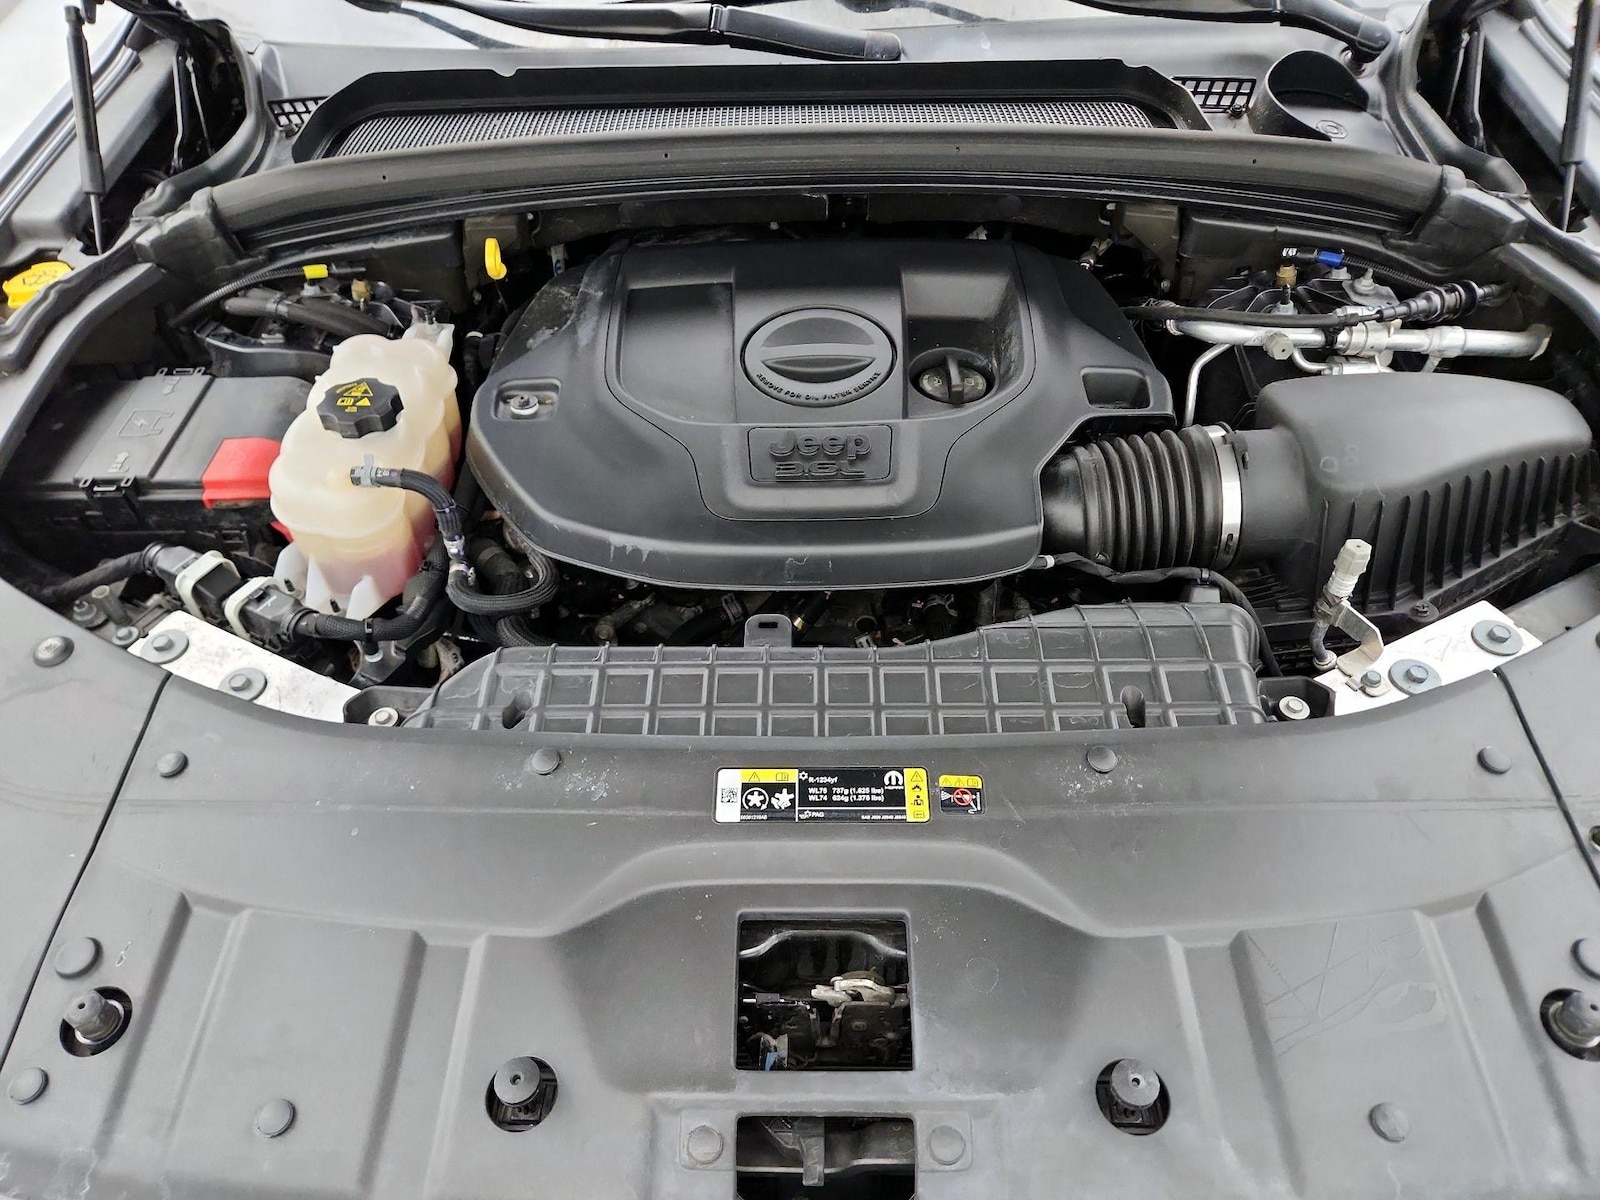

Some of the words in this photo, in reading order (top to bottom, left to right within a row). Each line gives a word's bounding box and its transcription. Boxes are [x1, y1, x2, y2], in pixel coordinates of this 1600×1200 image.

[756, 373, 783, 394] REMOVE
[784, 390, 802, 400] FOR
[822, 389, 852, 400] FILTER
[853, 371, 881, 393] SERVICE
[769, 430, 872, 460] Jeep
[774, 461, 866, 478] 3.6L
[808, 776, 838, 785] R-1234yf
[832, 787, 849, 795] 737g
[871, 787, 884, 795] lbs)
[808, 794, 828, 802] WL74
[832, 794, 849, 802] 624g
[871, 794, 884, 803] lbs)
